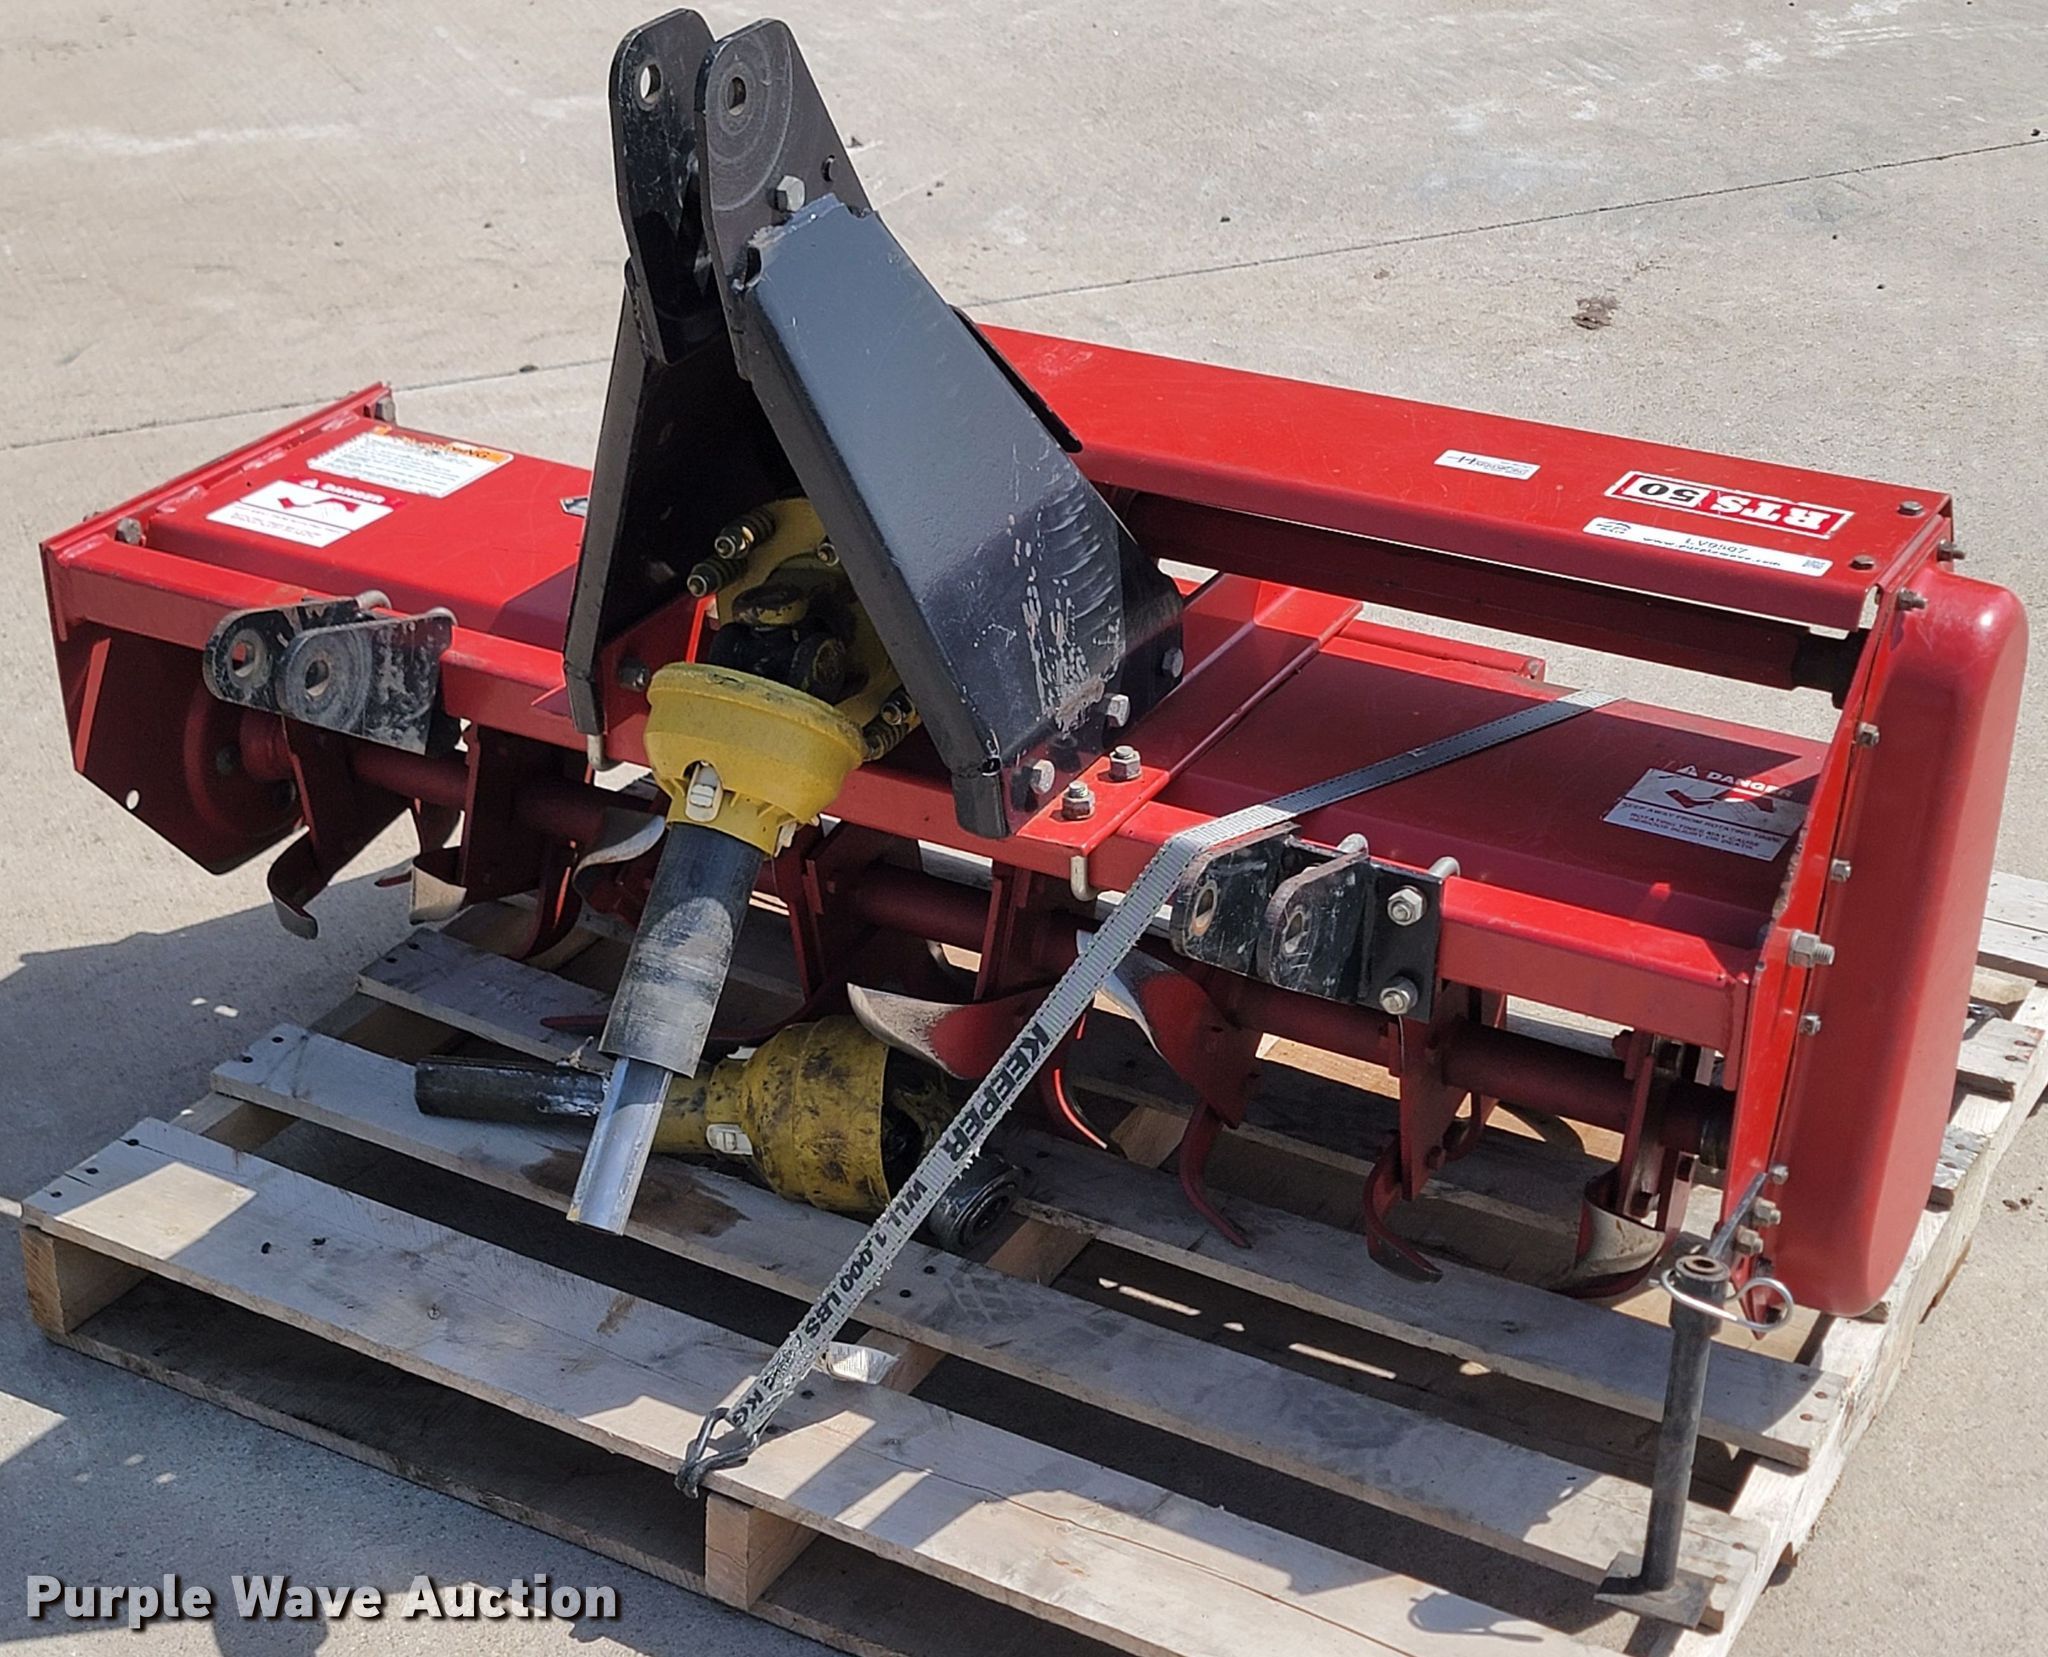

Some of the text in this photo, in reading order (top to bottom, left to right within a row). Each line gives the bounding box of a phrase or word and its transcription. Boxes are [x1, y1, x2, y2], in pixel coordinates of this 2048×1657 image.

[1638, 483, 1831, 530] RTS 50
[1706, 771, 1793, 798] DANGER
[940, 1022, 1050, 1162] KEEPER
[887, 1181, 928, 1228] WLL
[839, 1233, 887, 1292] 1,000
[805, 1293, 842, 1338] LBS
[732, 1390, 764, 1427] KG
